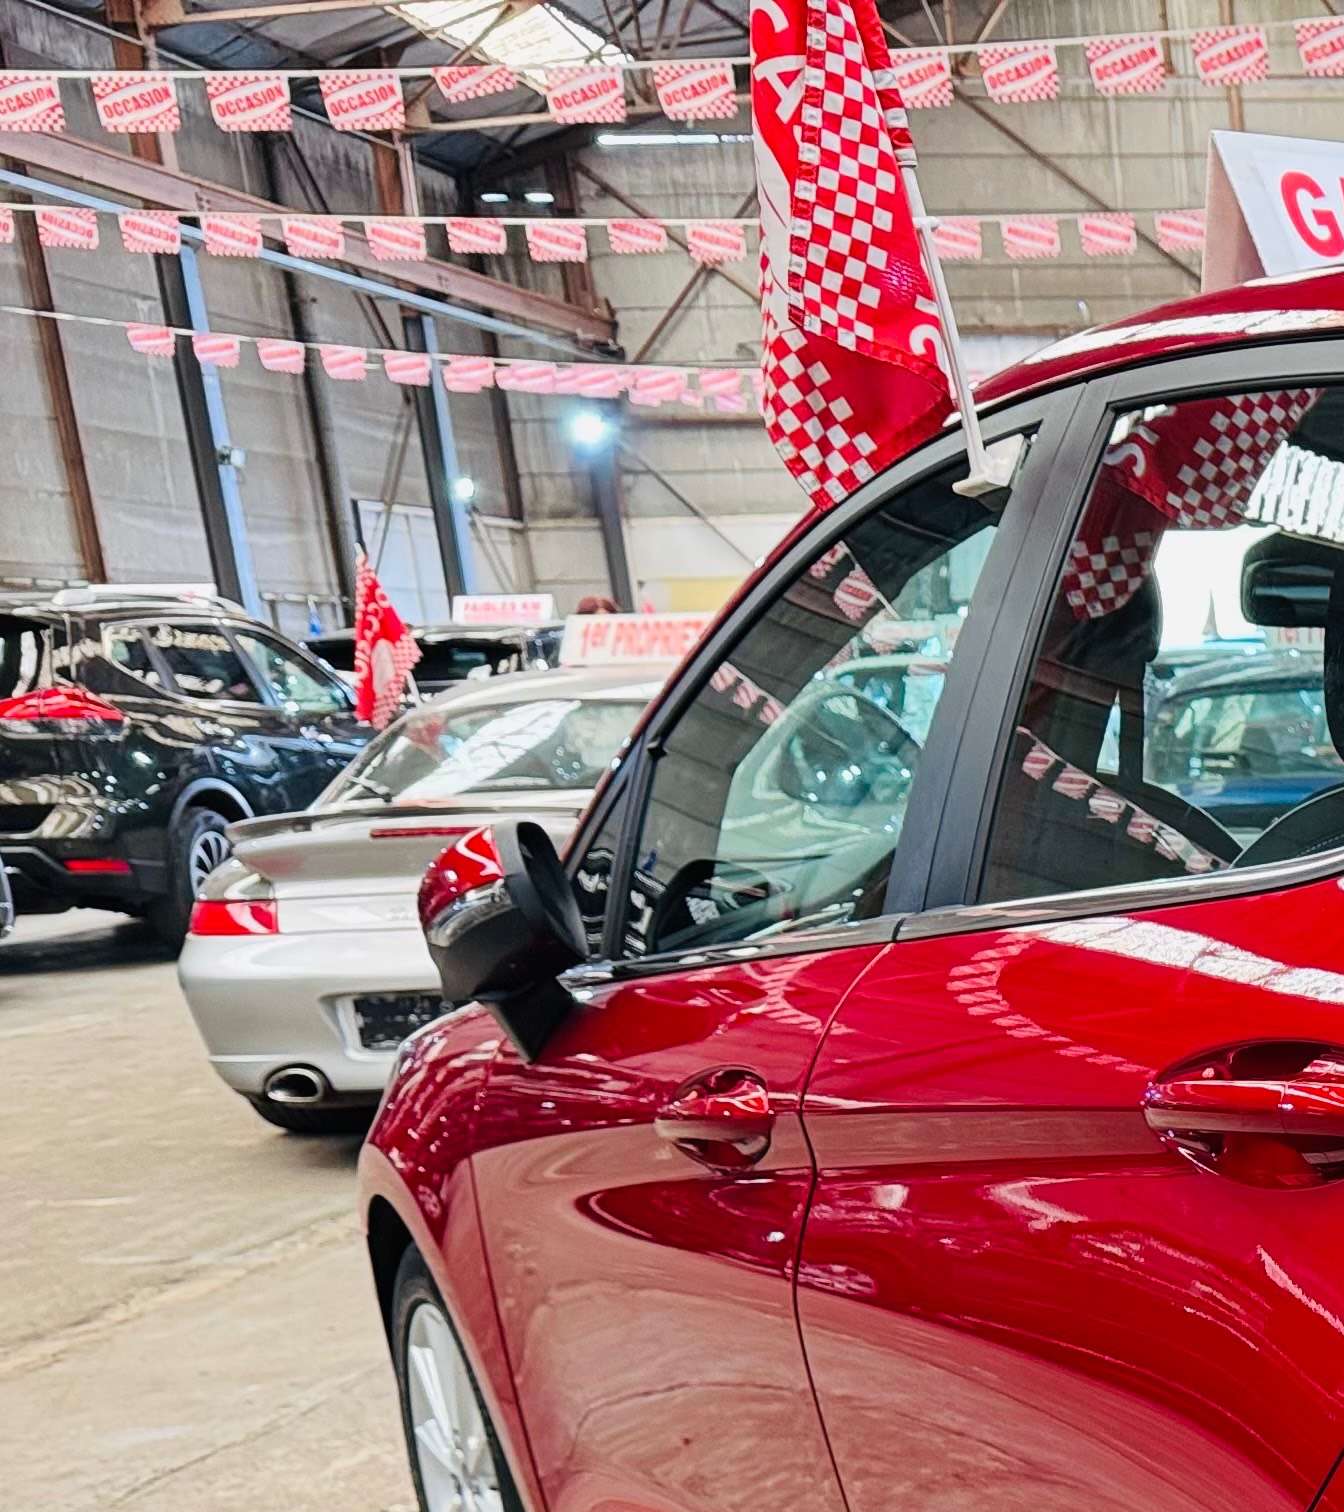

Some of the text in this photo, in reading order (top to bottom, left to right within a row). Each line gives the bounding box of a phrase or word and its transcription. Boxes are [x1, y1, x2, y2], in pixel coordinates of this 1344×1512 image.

[988, 55, 1052, 90] OCCASION
[1094, 47, 1158, 82] OCCASION
[1199, 38, 1264, 74] OCCASION
[102, 84, 172, 120] OCCASION
[215, 84, 284, 118] OCCASION
[329, 84, 398, 117] OCCASION
[551, 77, 618, 111] OCCASION
[662, 73, 729, 107] OCCASION
